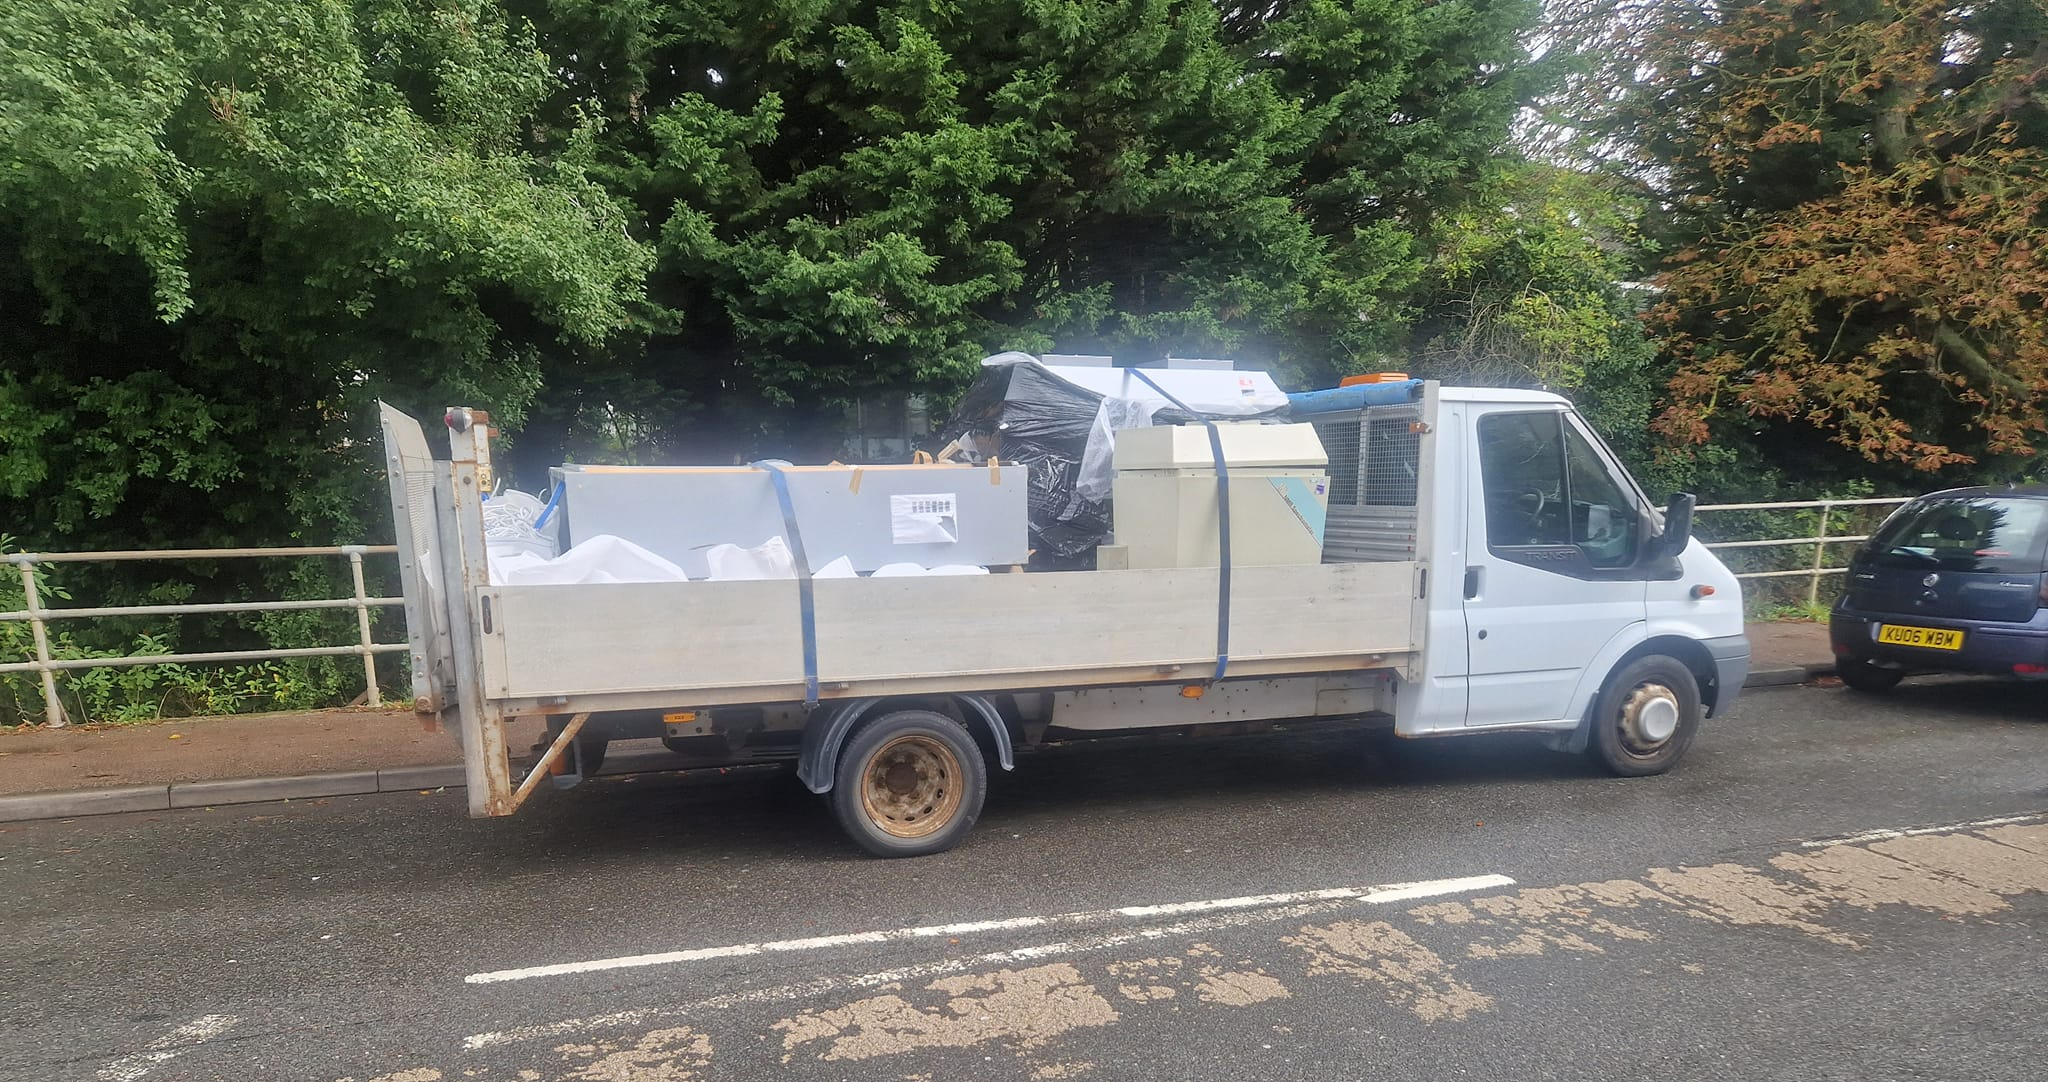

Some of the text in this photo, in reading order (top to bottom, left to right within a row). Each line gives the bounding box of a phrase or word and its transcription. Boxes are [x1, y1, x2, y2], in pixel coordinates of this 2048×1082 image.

[1525, 550, 1577, 561] TRANSIT
[1886, 627, 1954, 646] KU06 WBM
